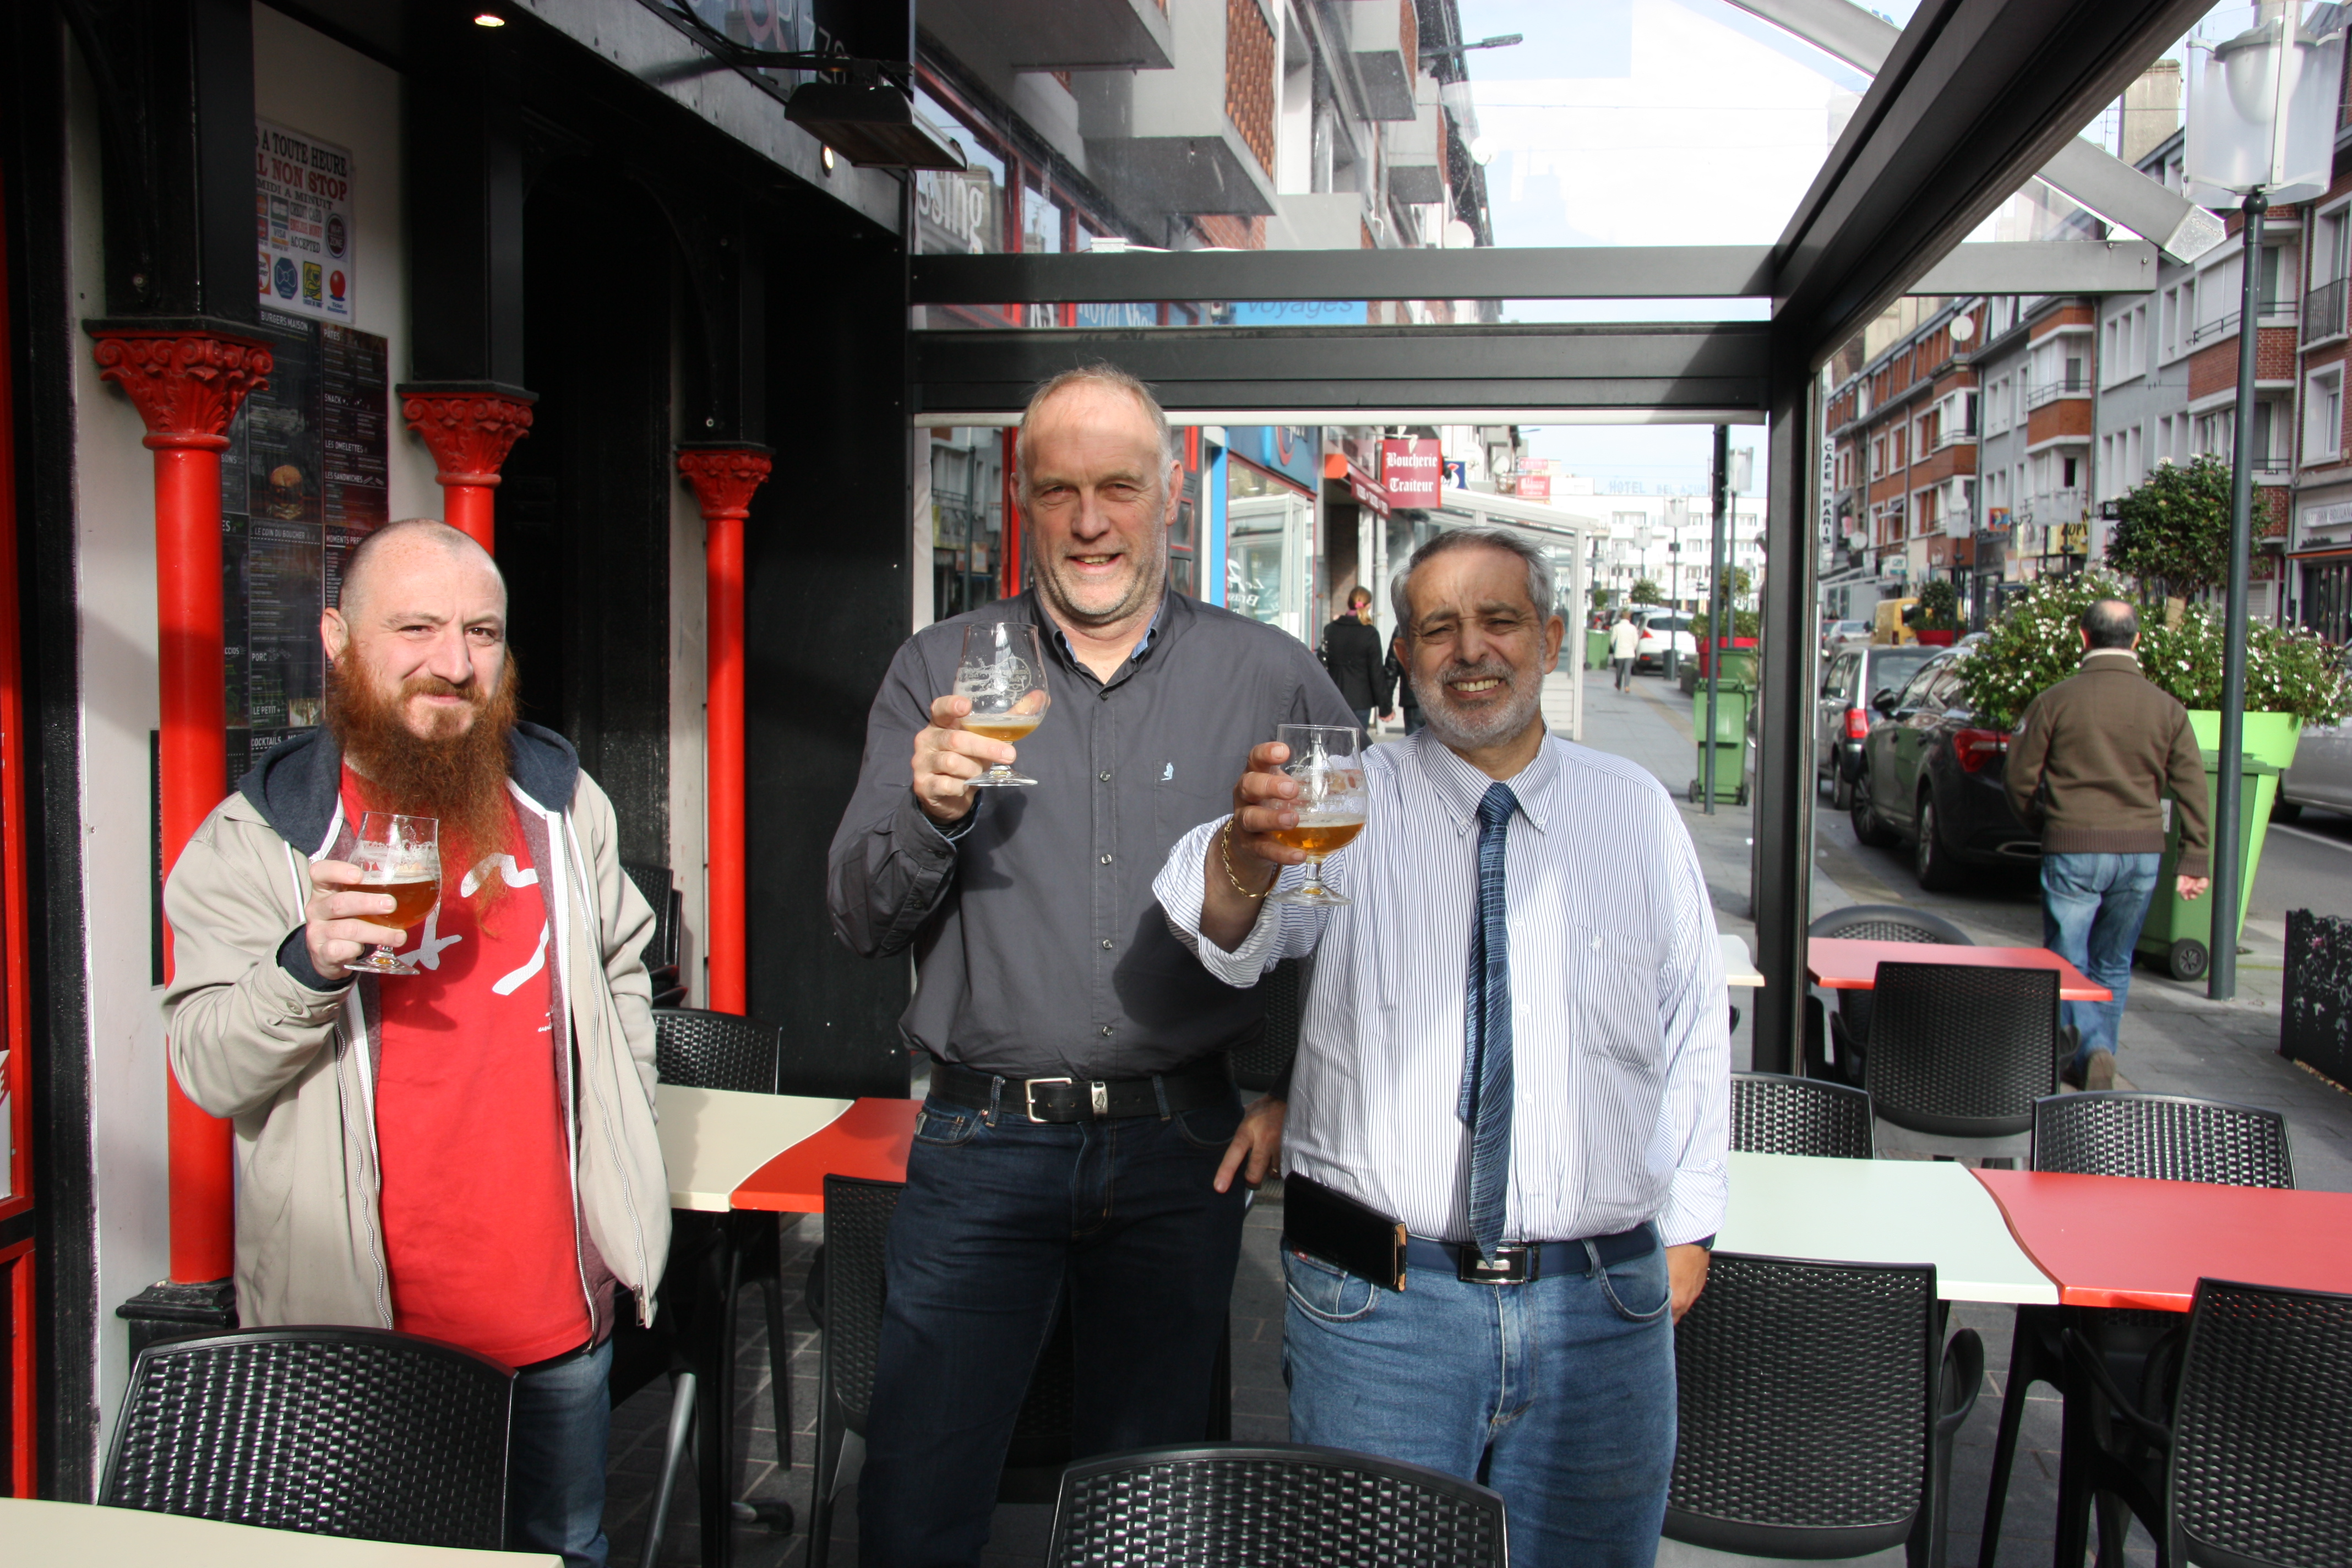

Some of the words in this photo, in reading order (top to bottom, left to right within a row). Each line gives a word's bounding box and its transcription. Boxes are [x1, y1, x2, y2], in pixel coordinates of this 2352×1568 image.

[262, 129, 270, 151] A
[272, 132, 308, 165] TOUTE
[311, 146, 347, 177] HEURE
[272, 157, 304, 189] NON
[308, 171, 347, 202] STOP
[285, 188, 292, 198] A
[295, 190, 334, 210] MINUIT
[291, 236, 321, 254] ACCEPTED
[260, 311, 287, 326] BURGERS
[287, 318, 309, 332] MAISON
[324, 393, 341, 405] SNACK
[324, 439, 334, 449] LES
[335, 442, 364, 454] OMELETTES
[1386, 452, 1439, 468] Boucherie
[1824, 444, 1833, 480] CAFE
[324, 471, 333, 480] LES
[334, 472, 363, 484] SANDWICHES
[1389, 477, 1434, 492] Traiteur
[1609, 480, 1646, 494] HOTEL
[1656, 484, 1675, 494] BEL
[2329, 507, 2352, 520] BOULAN
[1822, 499, 1832, 544] PARIS
[255, 527, 262, 536] LE
[262, 528, 274, 537] COIN
[275, 529, 282, 538] DU
[282, 530, 305, 540] BOUCHER
[326, 534, 350, 544] MOMENTS
[252, 652, 268, 662] PORC
[253, 706, 260, 715] LE
[261, 705, 276, 714] PETIT
[251, 736, 282, 747] COCKTAILS
